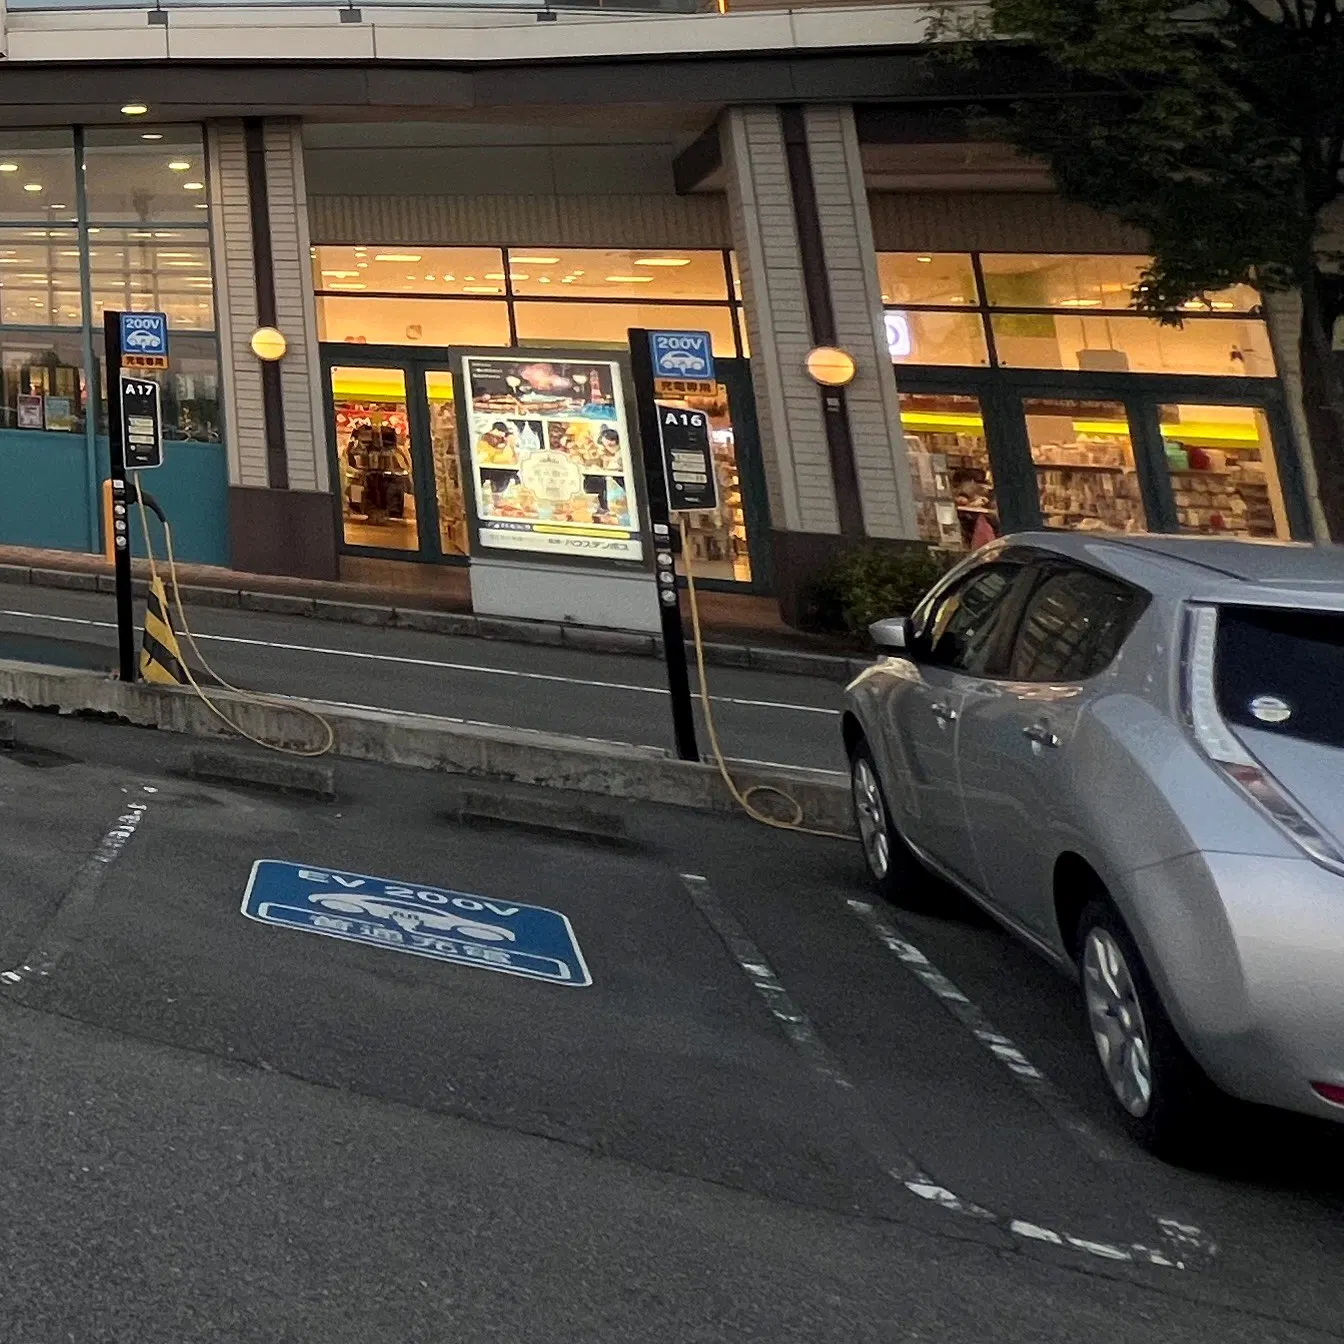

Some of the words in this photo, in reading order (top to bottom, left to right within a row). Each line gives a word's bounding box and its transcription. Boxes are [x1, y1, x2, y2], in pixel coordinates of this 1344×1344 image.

[125, 318, 160, 329] 200V
[656, 336, 703, 350] 200V
[125, 383, 154, 396] A17
[660, 380, 711, 393] 充電専用
[665, 412, 703, 427] A16
[298, 869, 366, 888] EV
[383, 885, 520, 917] 200V
